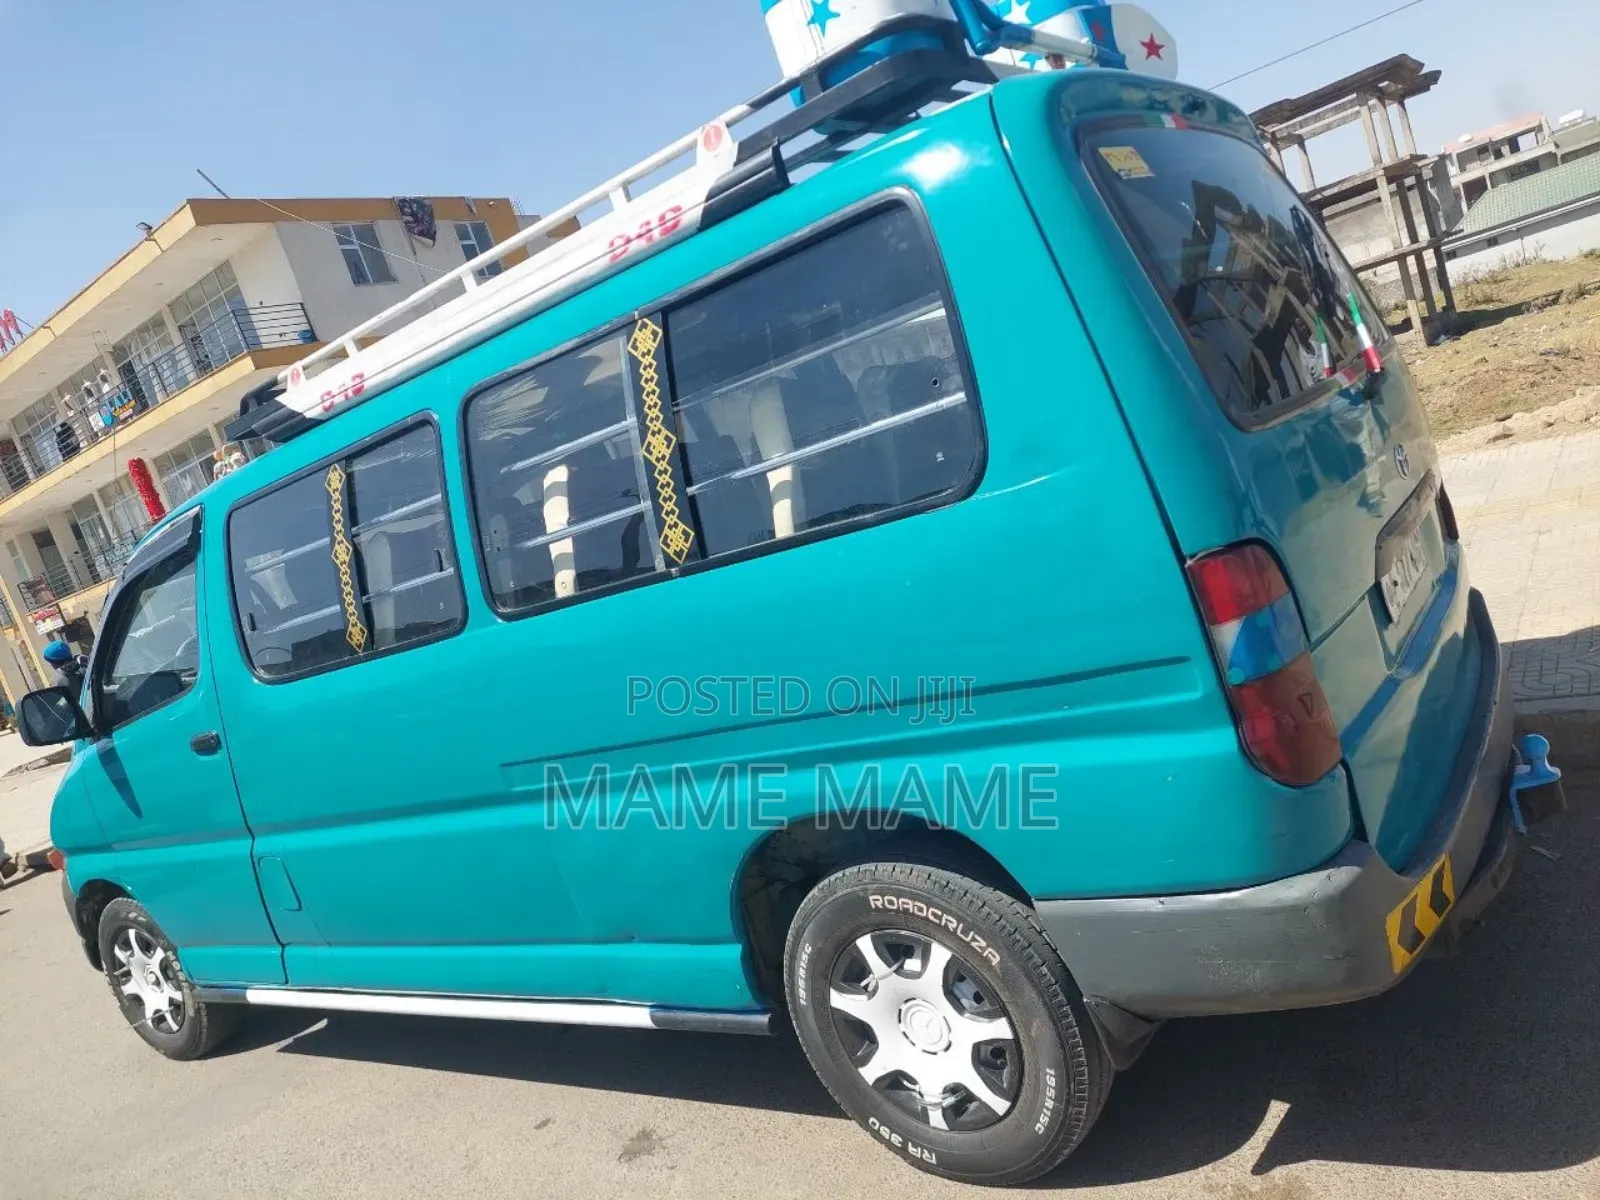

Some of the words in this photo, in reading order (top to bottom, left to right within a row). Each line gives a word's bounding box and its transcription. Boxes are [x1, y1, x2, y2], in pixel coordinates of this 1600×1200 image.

[868, 893, 1001, 967] ROADCRUZA
[1034, 1067, 1057, 1135] 195R15C
[907, 1141, 937, 1165] RA
